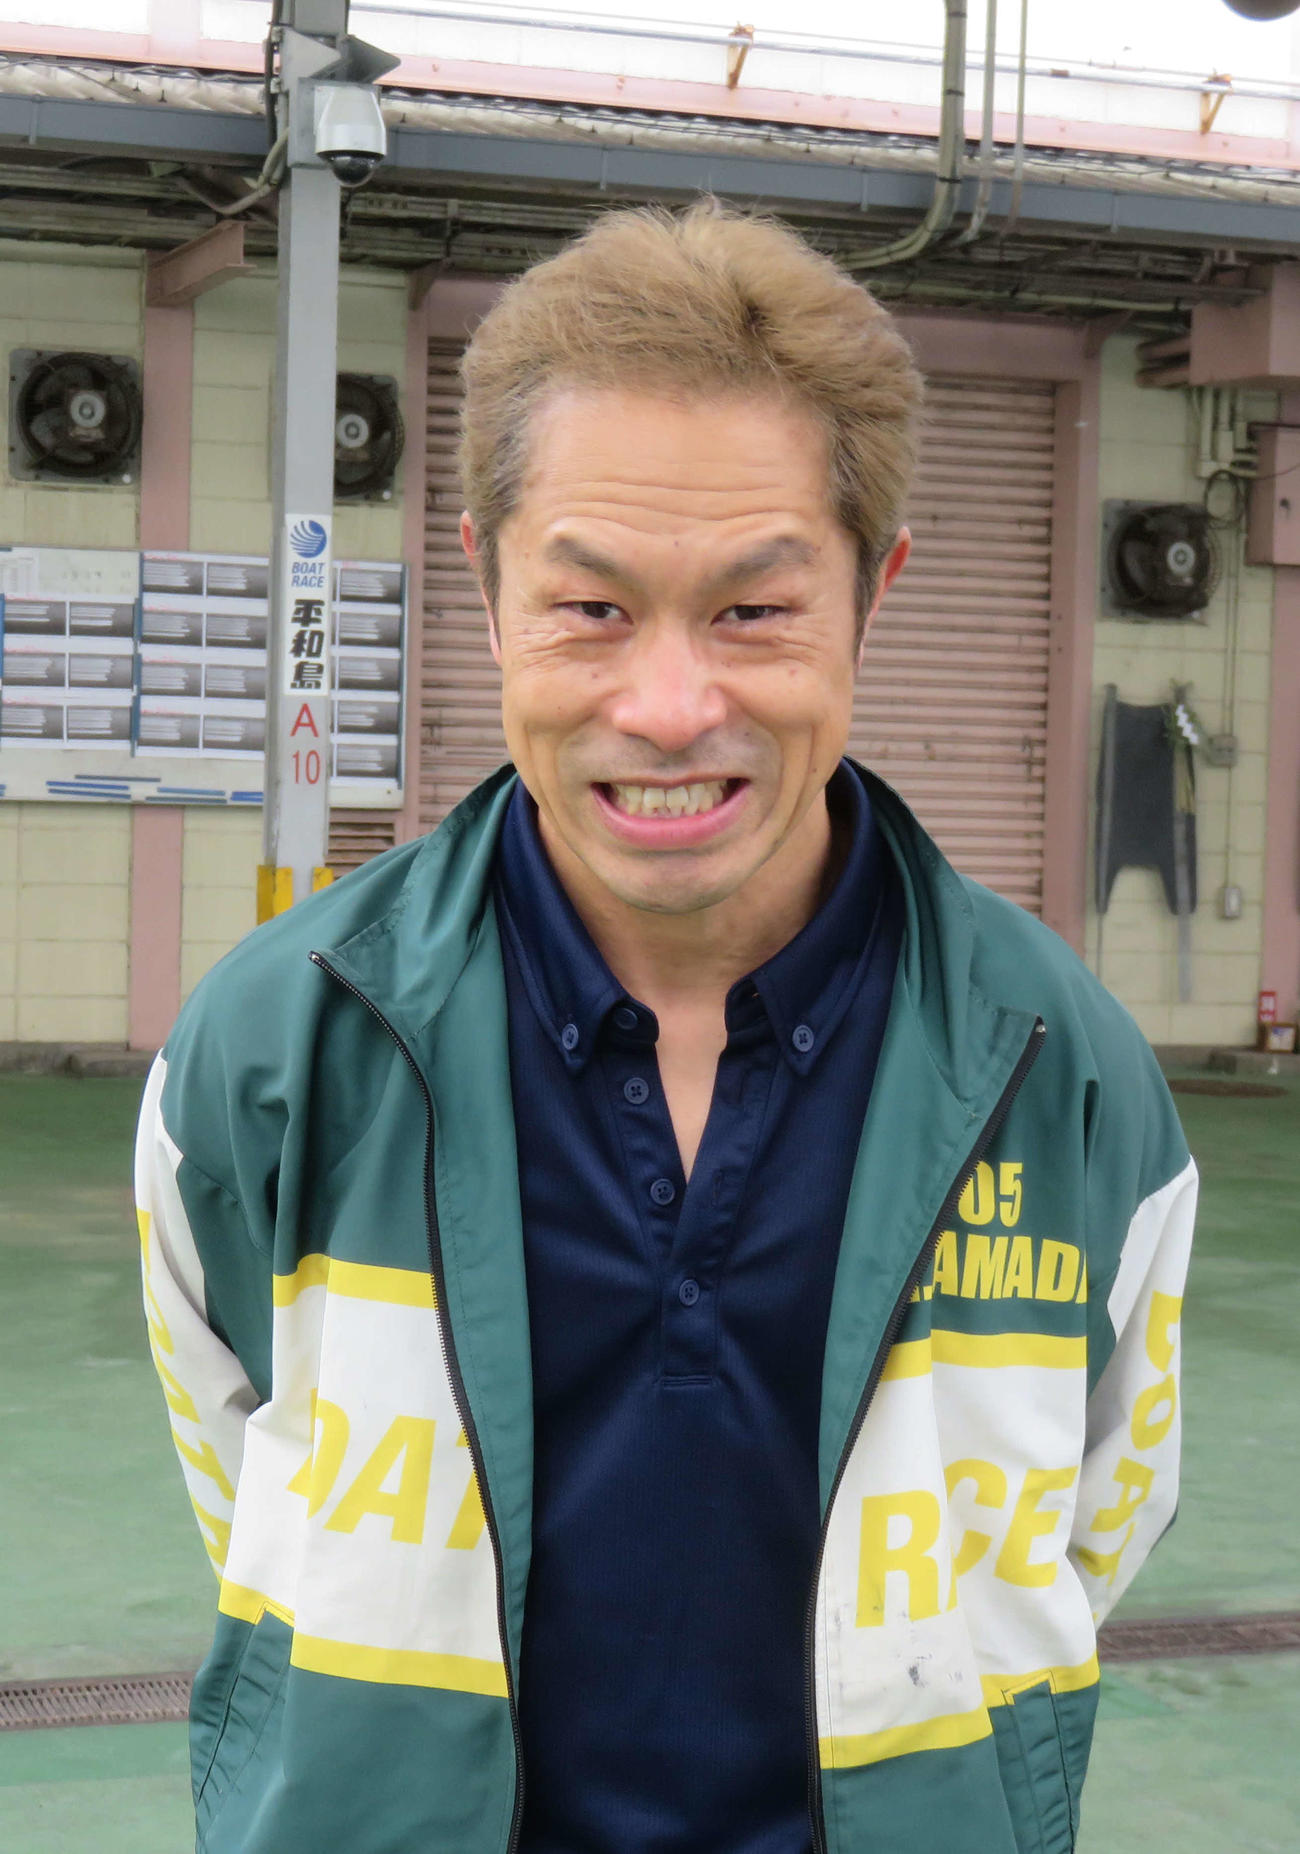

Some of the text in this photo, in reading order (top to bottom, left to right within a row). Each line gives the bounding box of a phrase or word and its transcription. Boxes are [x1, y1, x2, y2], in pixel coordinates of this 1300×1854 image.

[291, 562, 325, 574] BOAT
[291, 575, 325, 588] RACE
[290, 598, 326, 690] 平和島
[290, 702, 319, 738] A
[291, 749, 321, 785] 10
